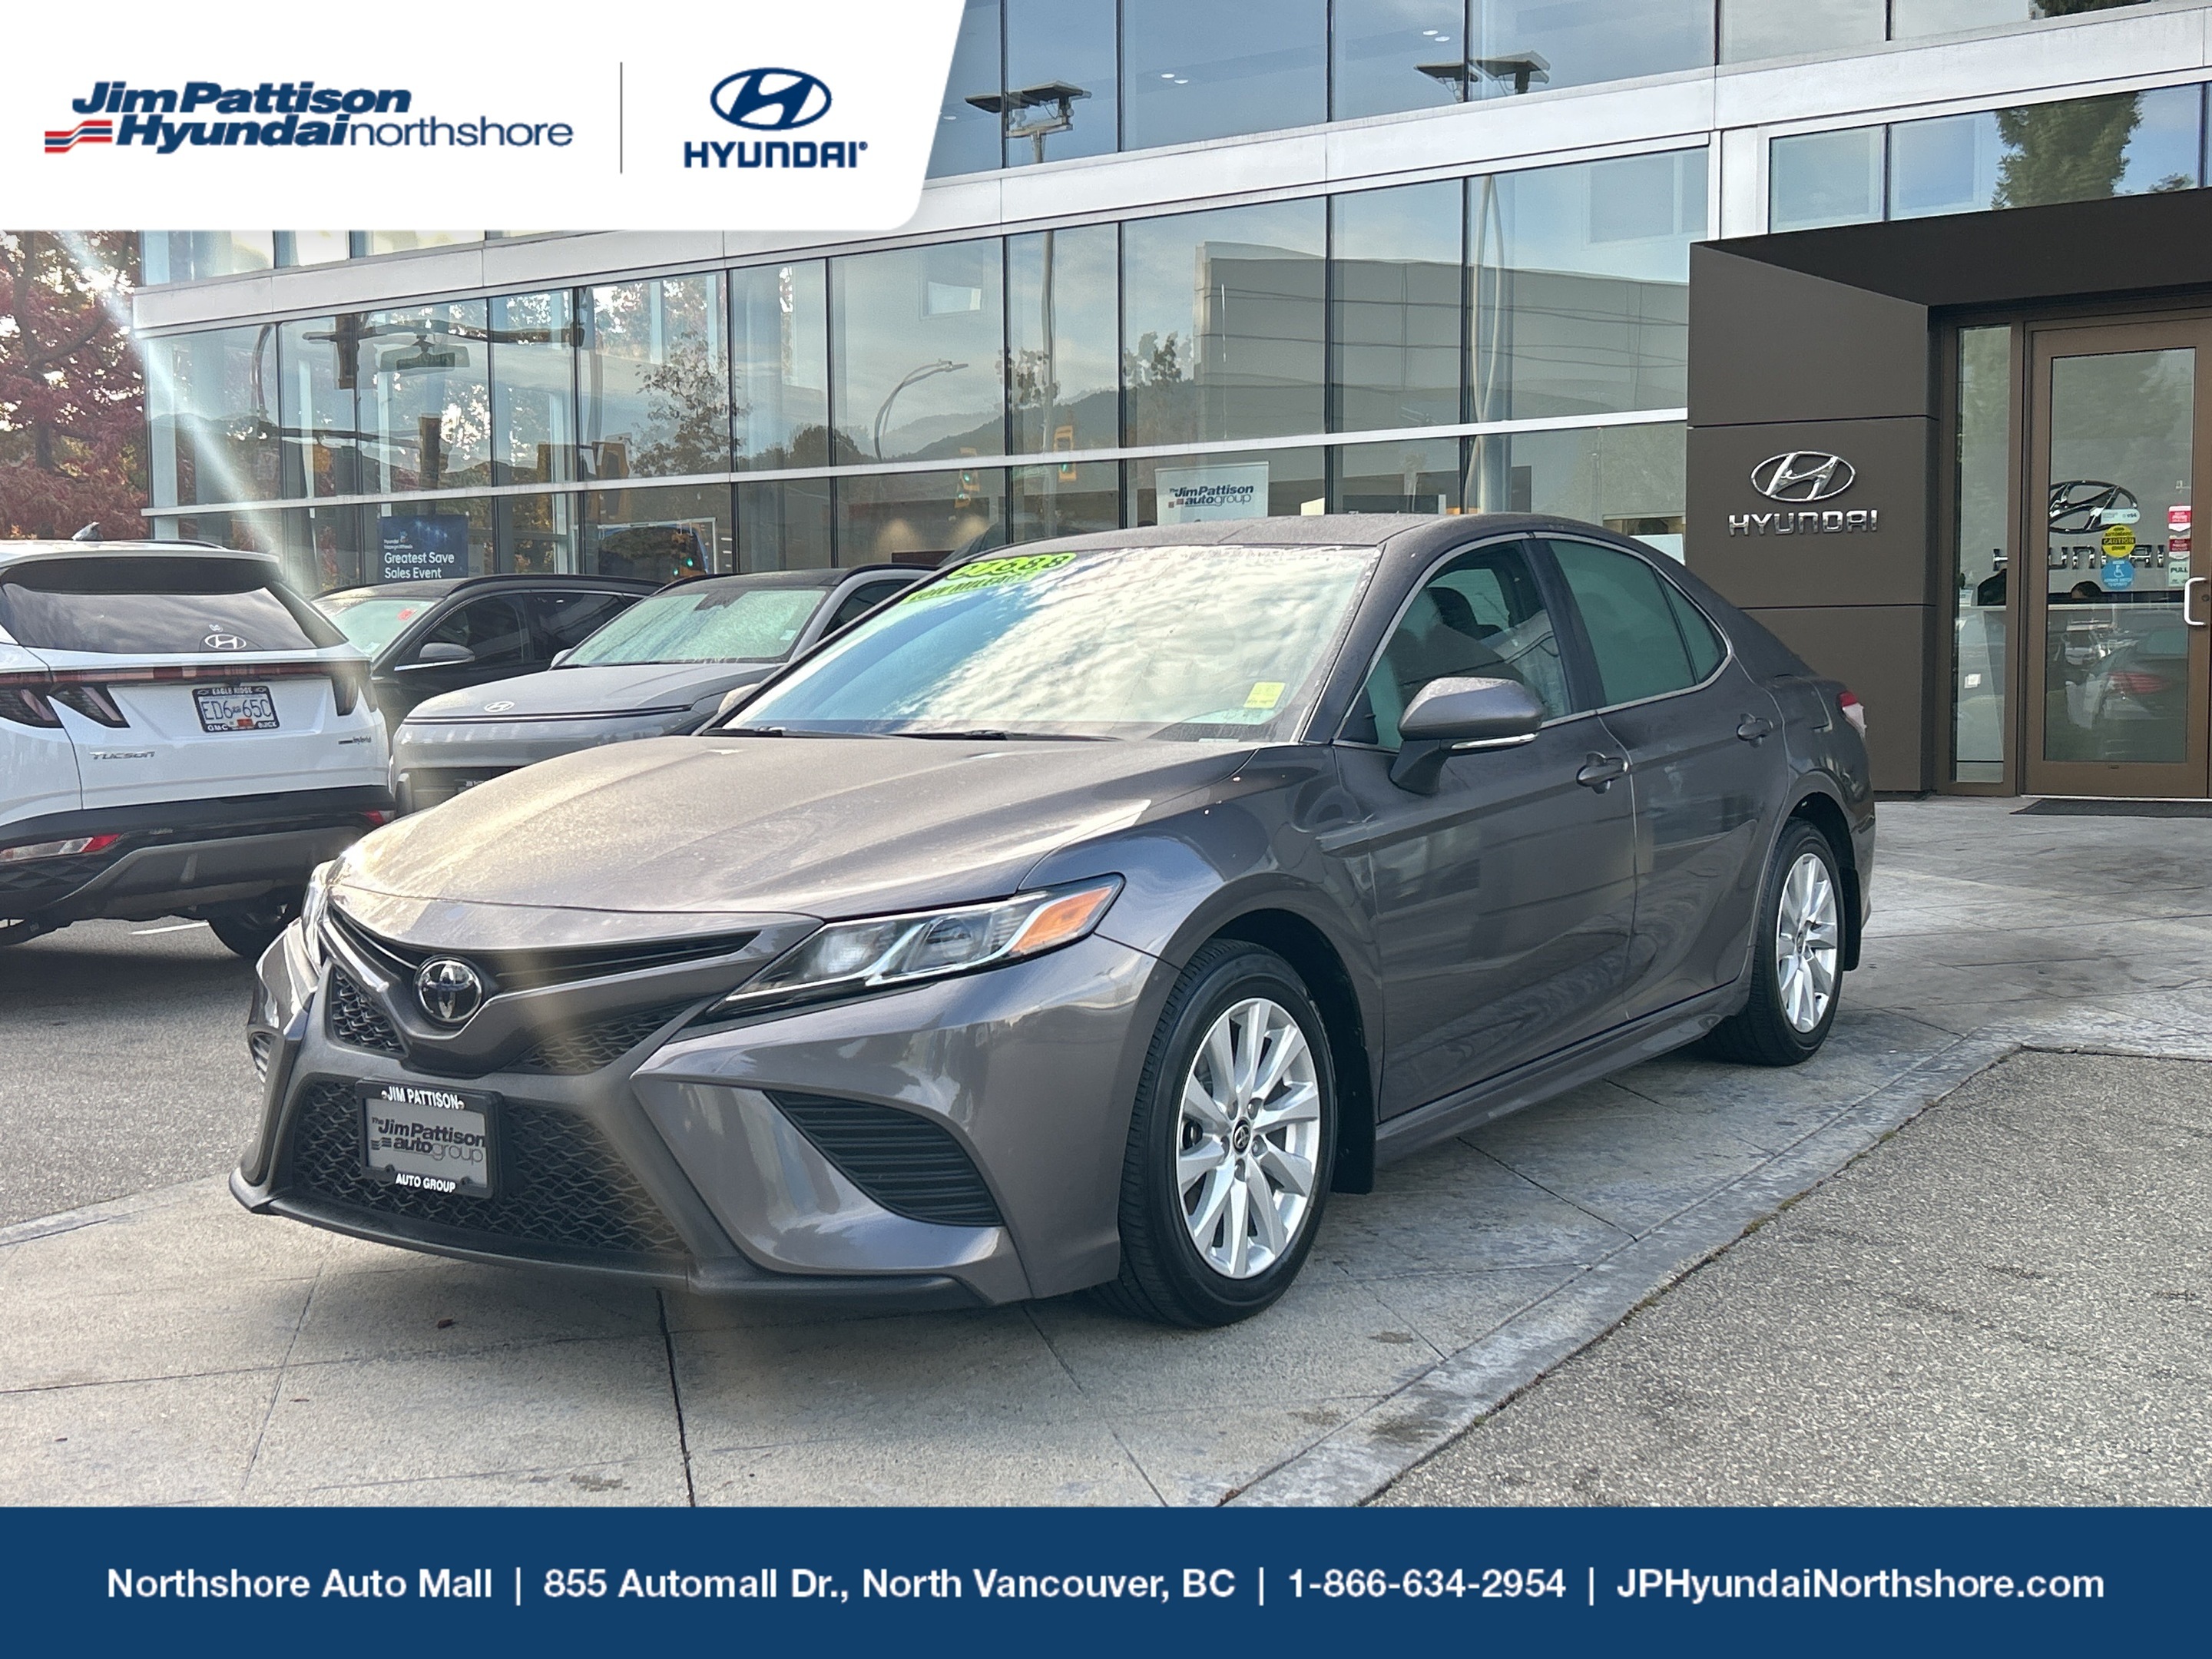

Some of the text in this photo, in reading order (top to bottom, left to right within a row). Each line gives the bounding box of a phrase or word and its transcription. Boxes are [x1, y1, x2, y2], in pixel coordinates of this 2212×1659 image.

[1729, 509, 1878, 537] HYUNDAI
[384, 551, 455, 564] Greatest Save
[384, 567, 442, 578] Sales Event
[200, 700, 233, 720] ED6
[89, 751, 155, 760] TUCSON
[387, 1086, 459, 1110] JIM PATTISON
[372, 1116, 384, 1125] The
[396, 1173, 456, 1193] AUTO GROUP
